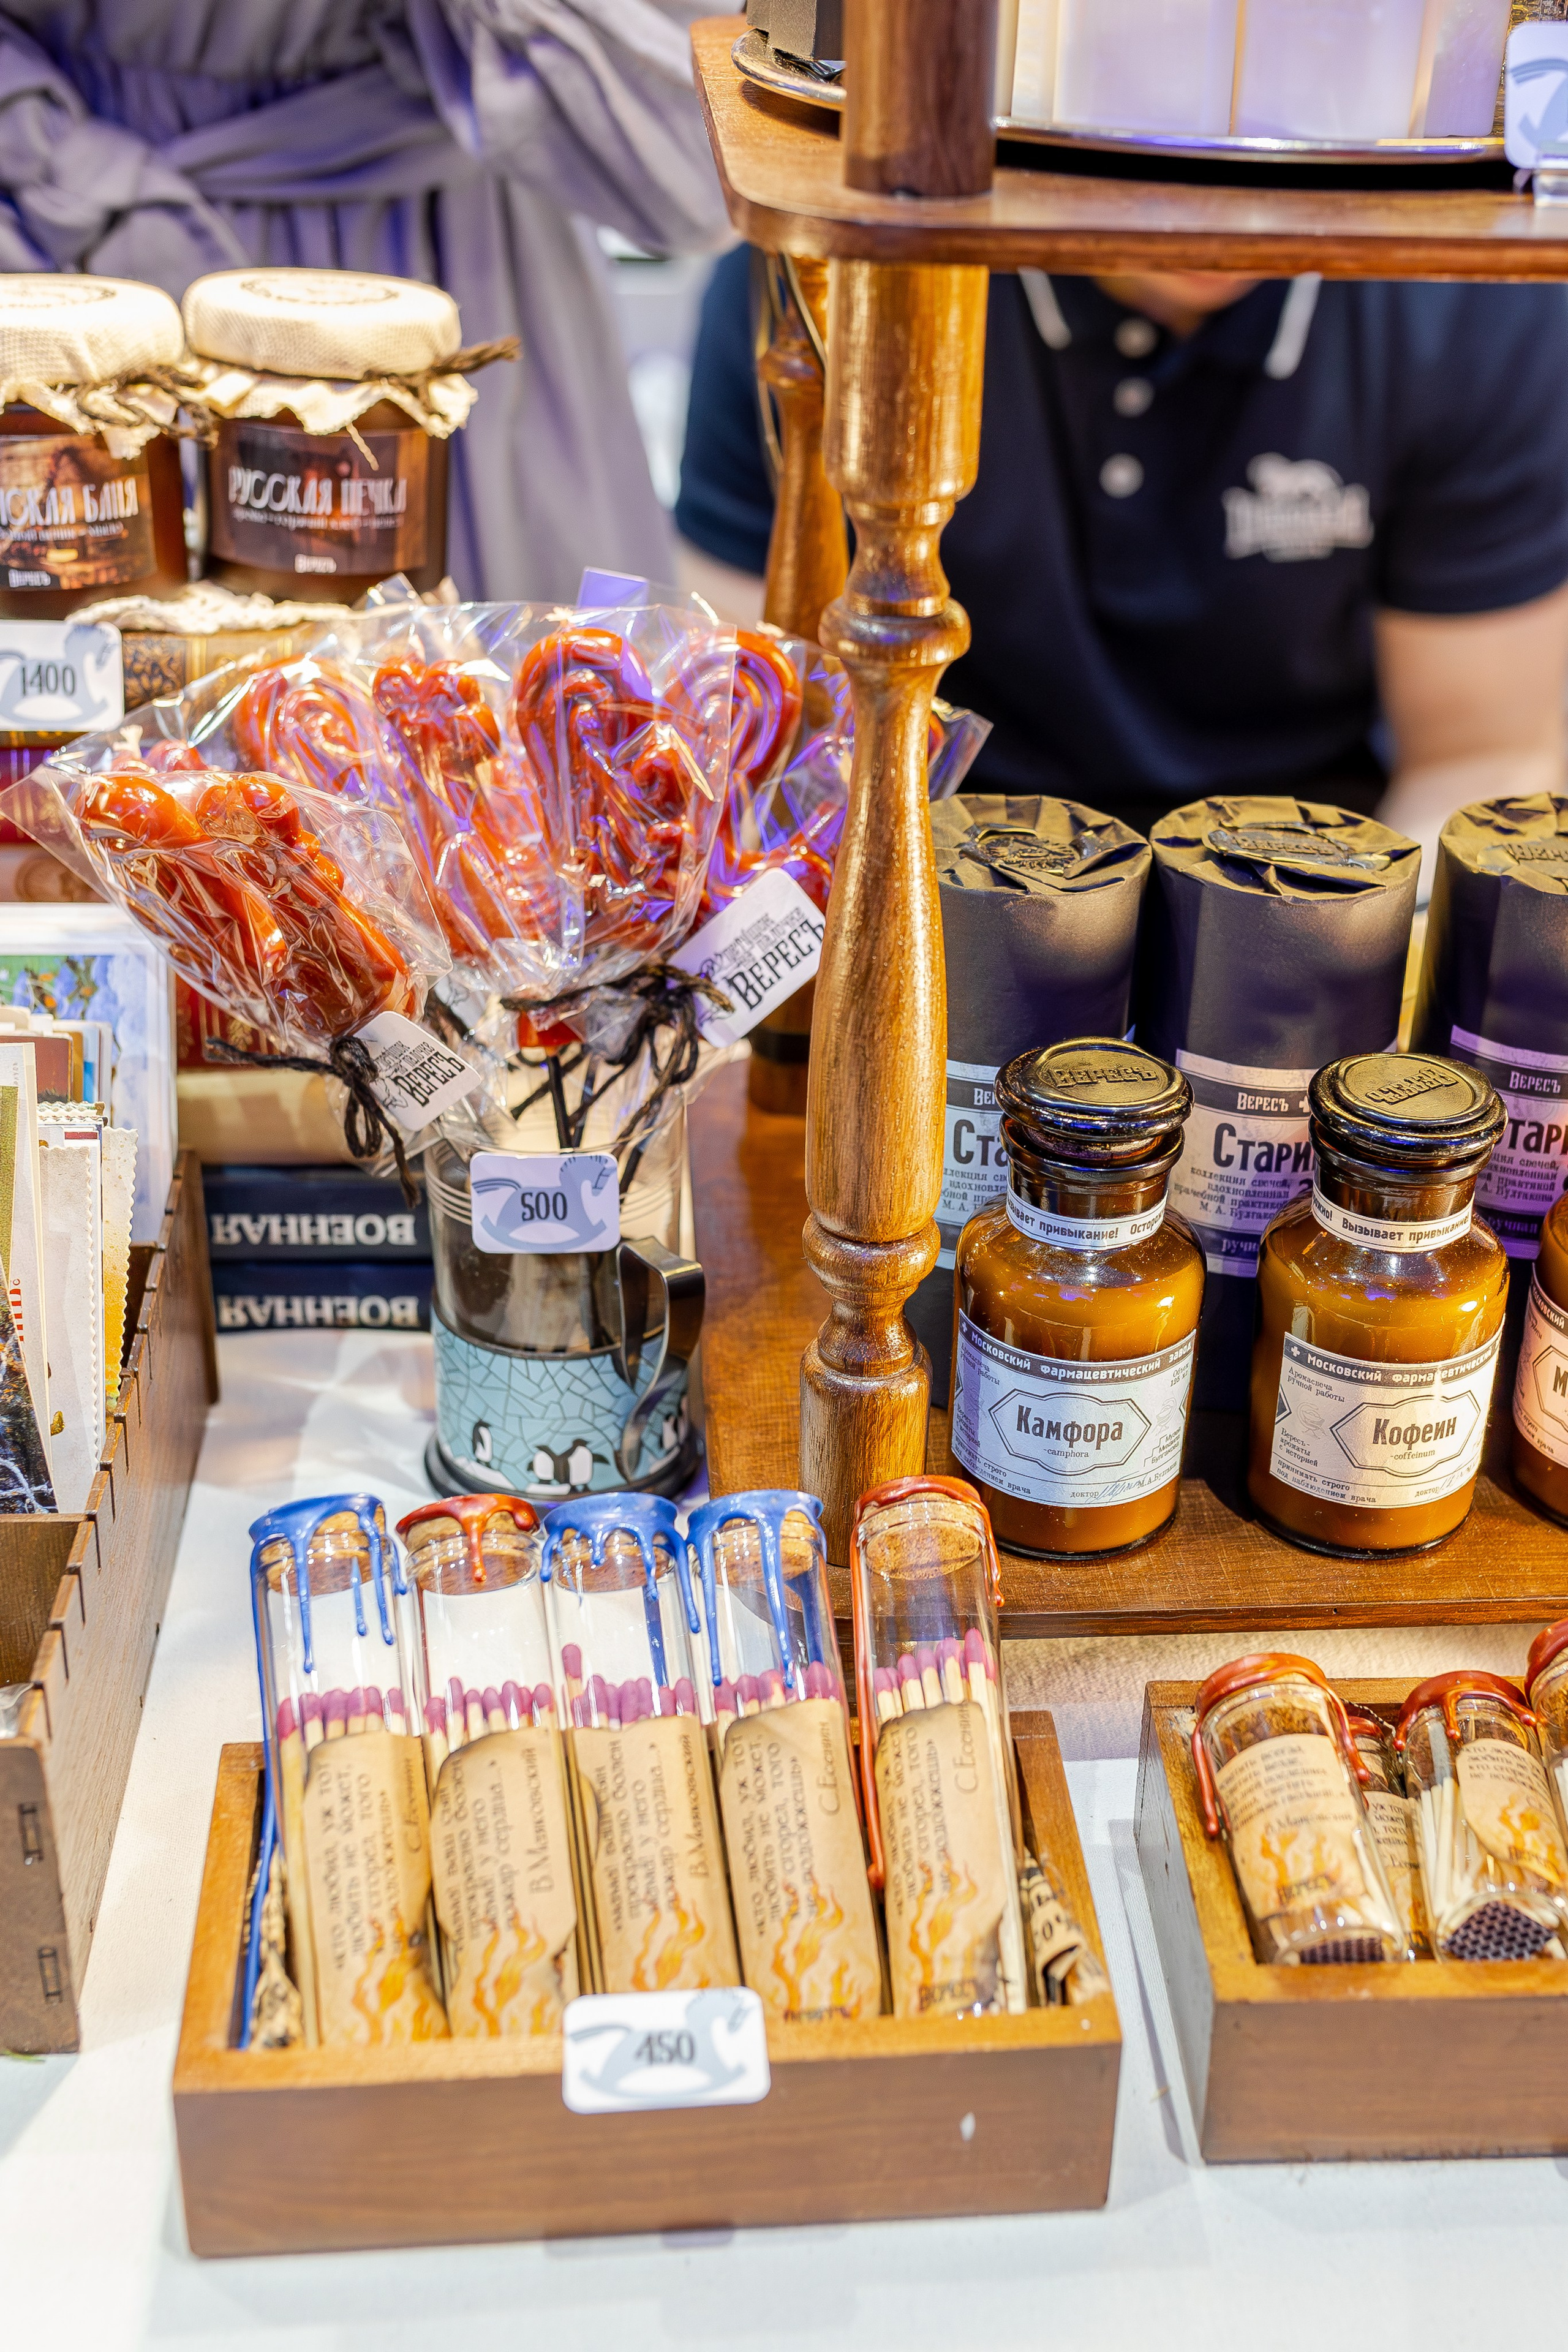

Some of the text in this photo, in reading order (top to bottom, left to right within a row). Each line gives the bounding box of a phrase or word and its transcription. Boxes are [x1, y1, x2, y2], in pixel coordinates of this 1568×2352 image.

[0, 486, 76, 526] СКАЯ
[20, 663, 77, 698] 1400
[953, 1118, 1009, 1167] Ста
[521, 1191, 568, 1221] 500
[211, 1213, 417, 1246] ВОЕННАЯ
[1039, 1221, 1119, 1241] привыкание!
[1342, 1216, 1404, 1241] Вызывает
[1408, 1212, 1470, 1244] привыкание!
[218, 1295, 419, 1328] ВОЕННАЯ
[971, 1330, 1192, 1381] Московский фармацевтический завод
[1306, 1347, 1493, 1386] Московский фармаевтический
[1287, 1374, 1346, 1403] ручной работы
[1288, 1366, 1333, 1392] Аромасвеча
[1016, 1404, 1124, 1450] Камфора
[1372, 1415, 1458, 1451] Кофеин
[1280, 1436, 1311, 1457] ароматы
[1285, 1448, 1319, 1468] историей
[983, 1461, 1008, 1477] строго
[1277, 1458, 1351, 1492] принимать строго
[1006, 1480, 1031, 1495] врача
[1069, 1490, 1100, 1501] доктор
[1291, 1476, 1347, 1499] наблюдением
[1350, 1494, 1377, 1504] врача
[635, 2029, 696, 2067] 450
